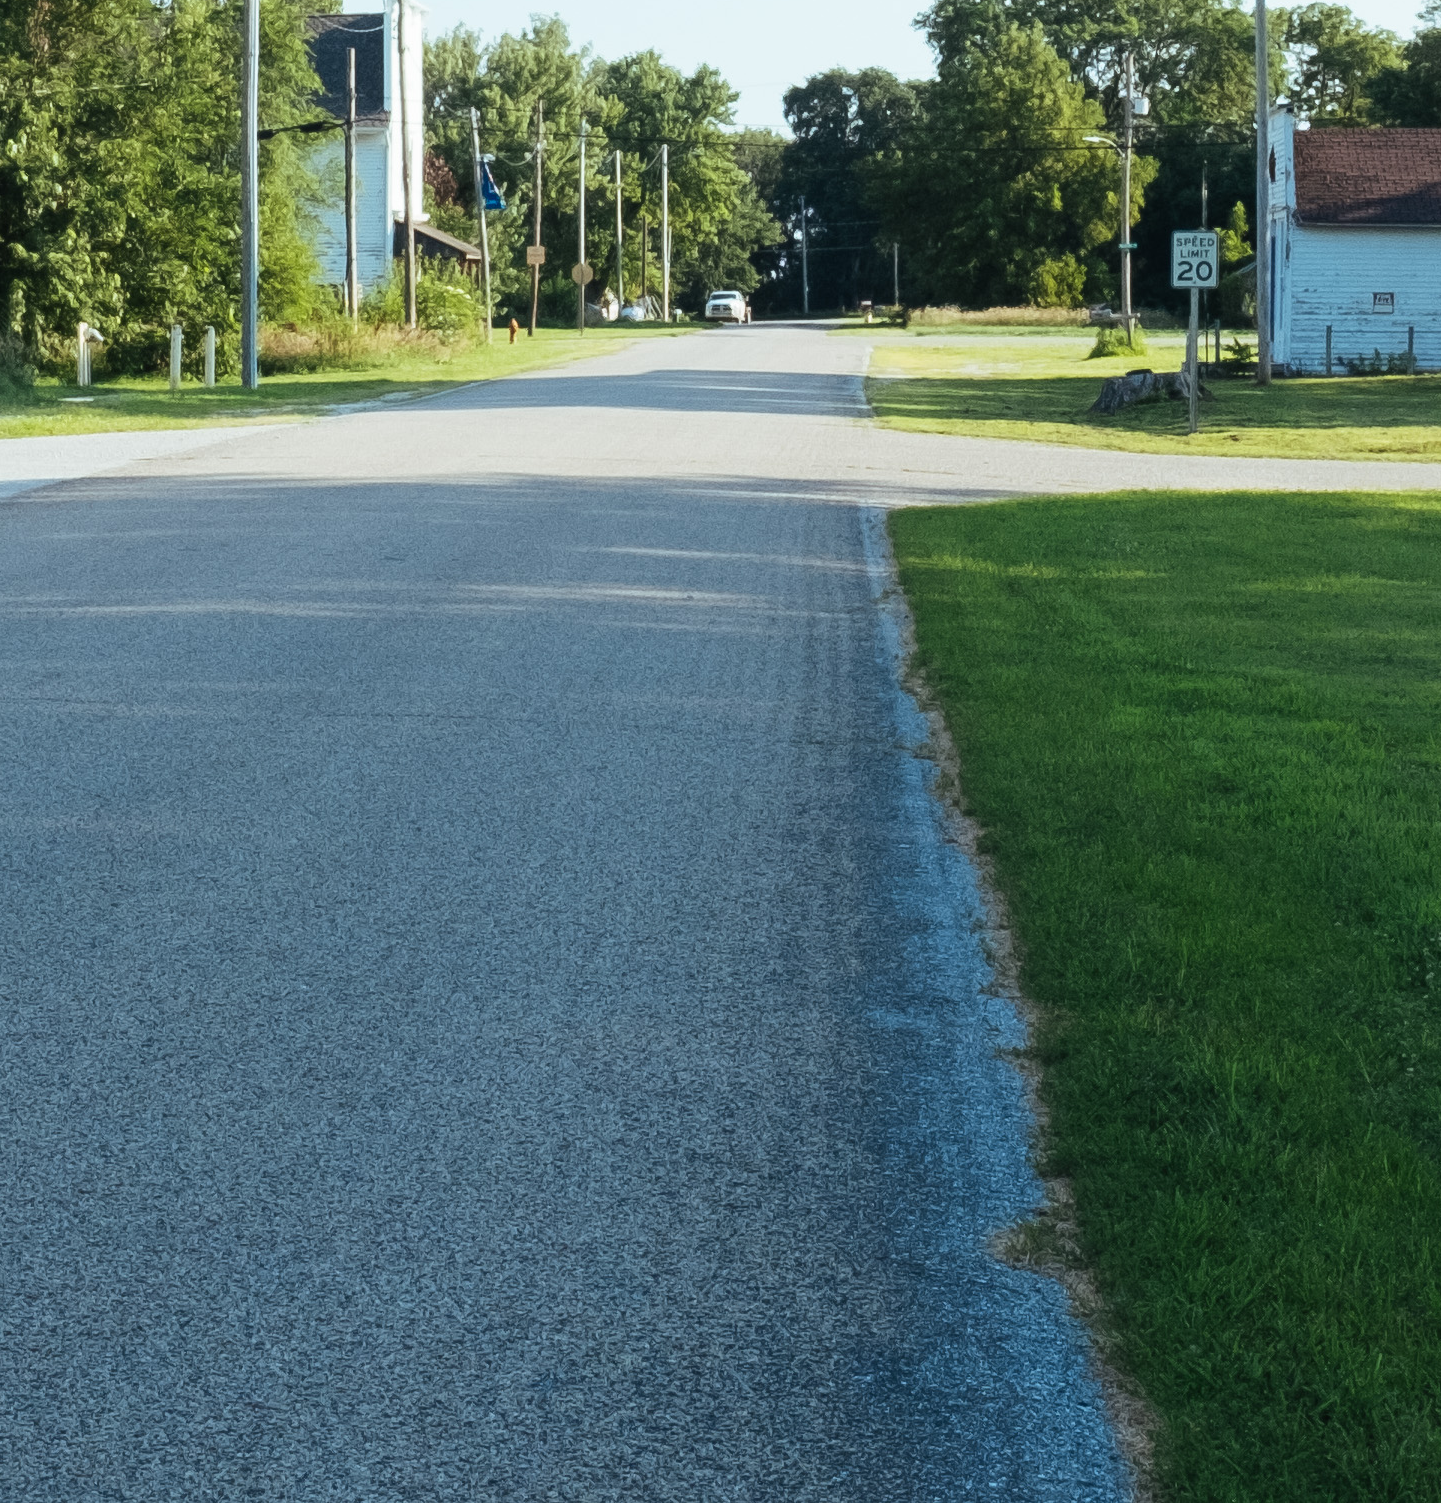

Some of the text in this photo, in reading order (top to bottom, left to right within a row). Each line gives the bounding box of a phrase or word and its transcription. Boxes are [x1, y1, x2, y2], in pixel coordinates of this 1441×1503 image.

[1176, 235, 1215, 248] SPEED
[1180, 248, 1210, 259] LIMIT
[1177, 260, 1213, 282] 20
